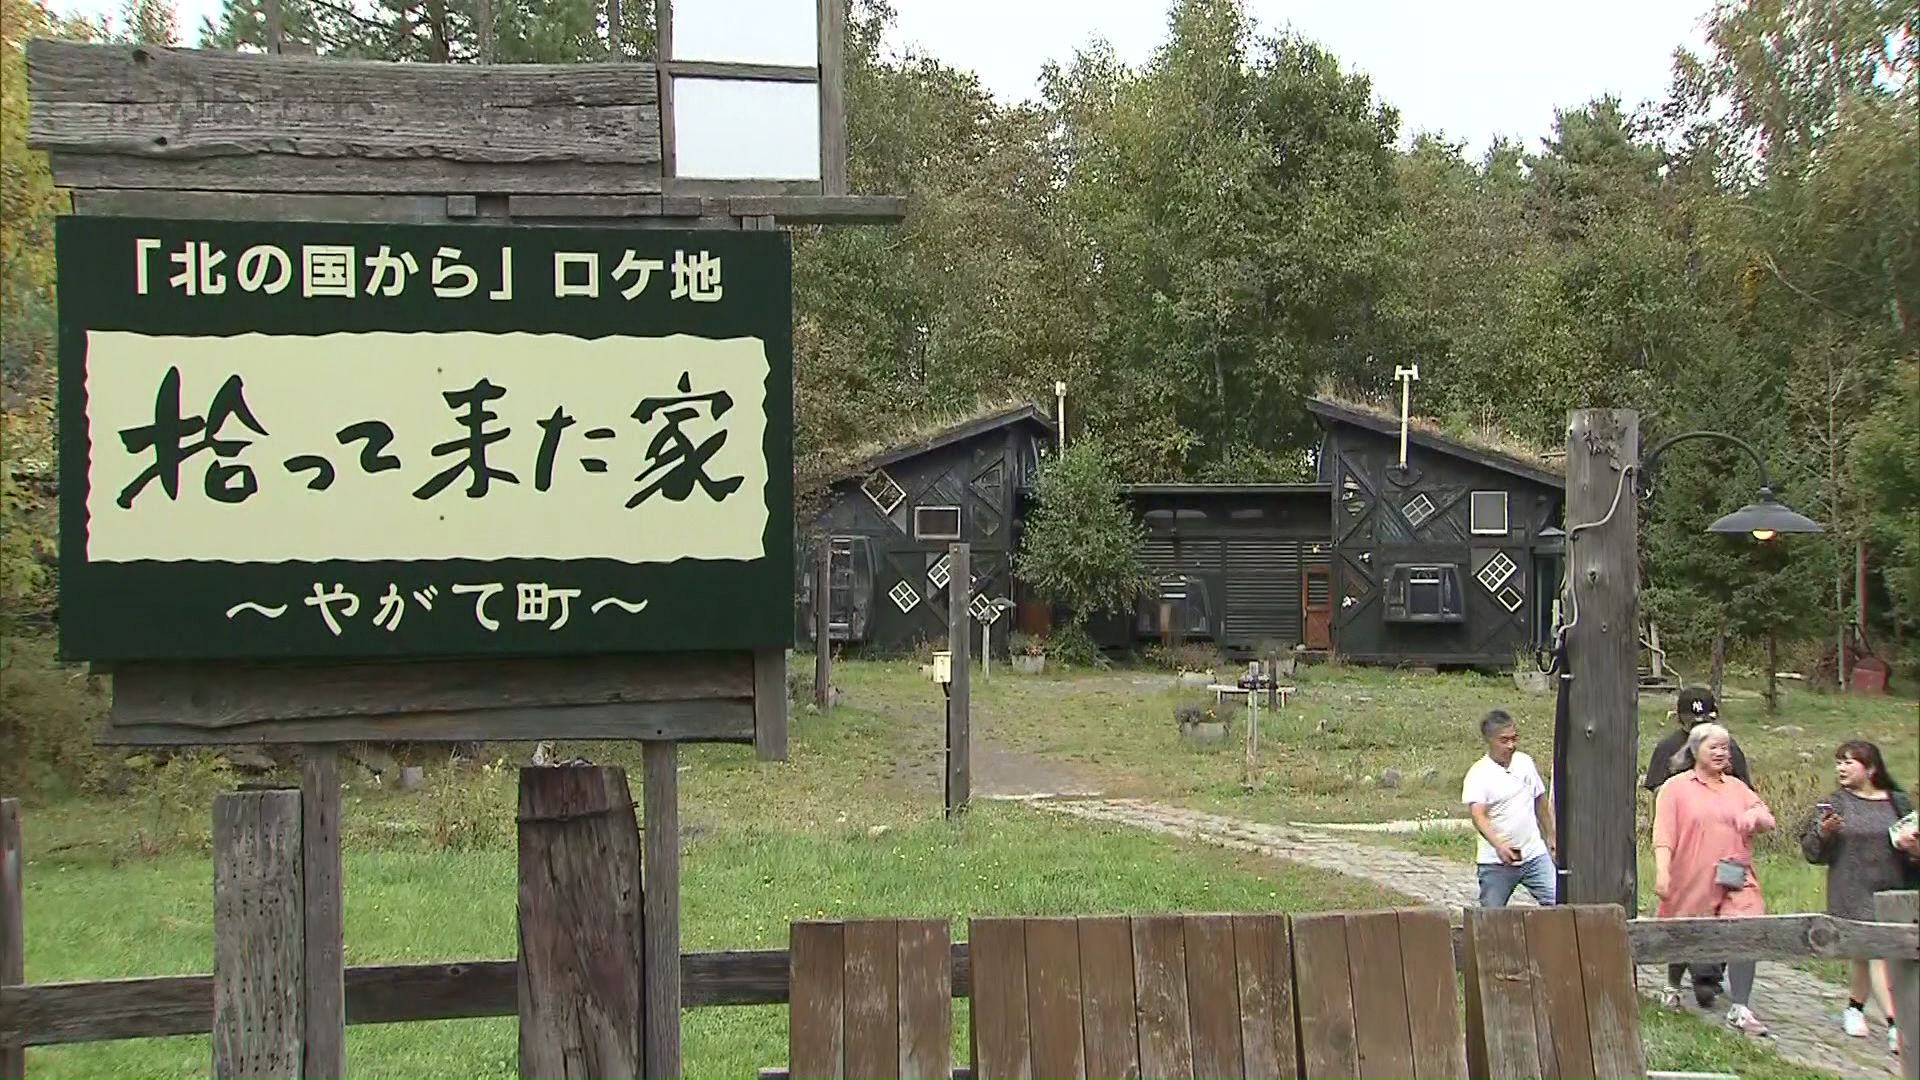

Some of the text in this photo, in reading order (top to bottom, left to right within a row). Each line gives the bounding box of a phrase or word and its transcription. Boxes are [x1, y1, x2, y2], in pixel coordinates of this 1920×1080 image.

[117, 366, 745, 510] 拾って来た家
